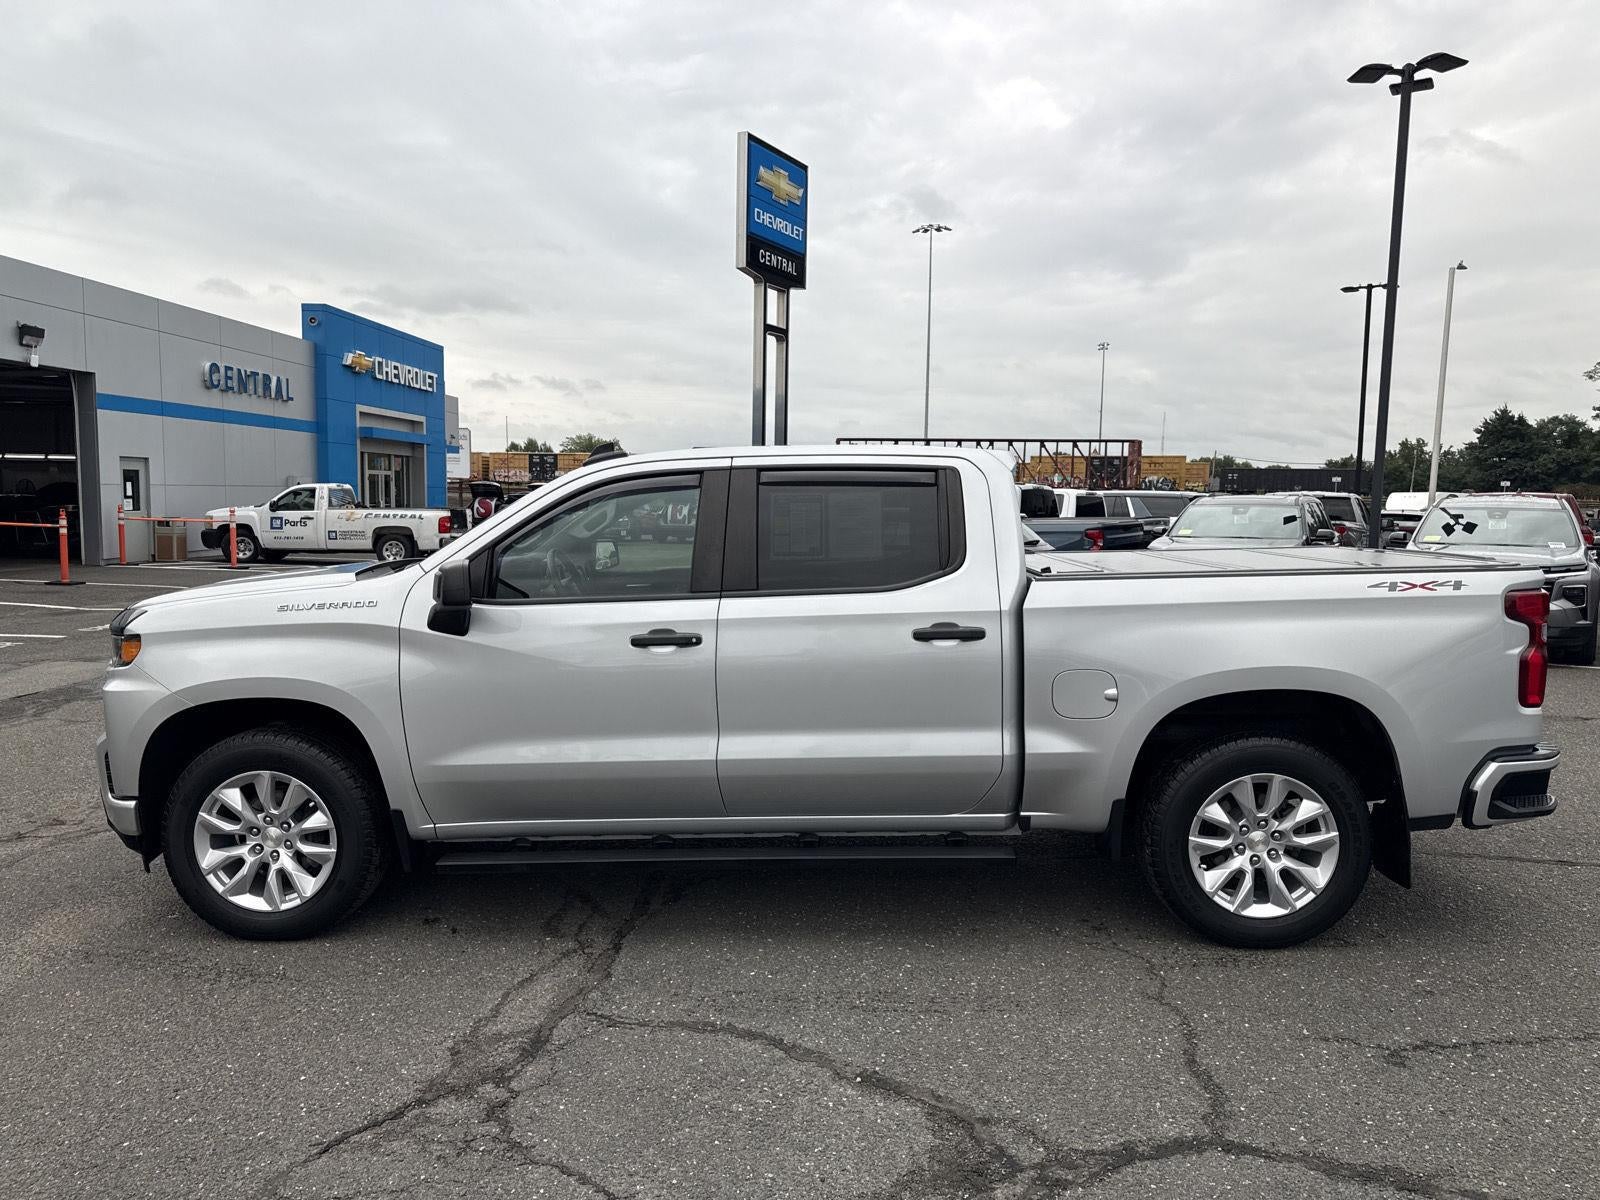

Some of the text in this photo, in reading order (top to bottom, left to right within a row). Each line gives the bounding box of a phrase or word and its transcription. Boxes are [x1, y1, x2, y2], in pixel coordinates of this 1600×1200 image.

[755, 208, 803, 240] CHEVROLET
[759, 250, 797, 275] CENTRAL
[204, 361, 294, 402] CENTRAL
[375, 356, 438, 392] CHEVROLET
[284, 519, 308, 527] Parts
[277, 600, 378, 612] SILVERADO
